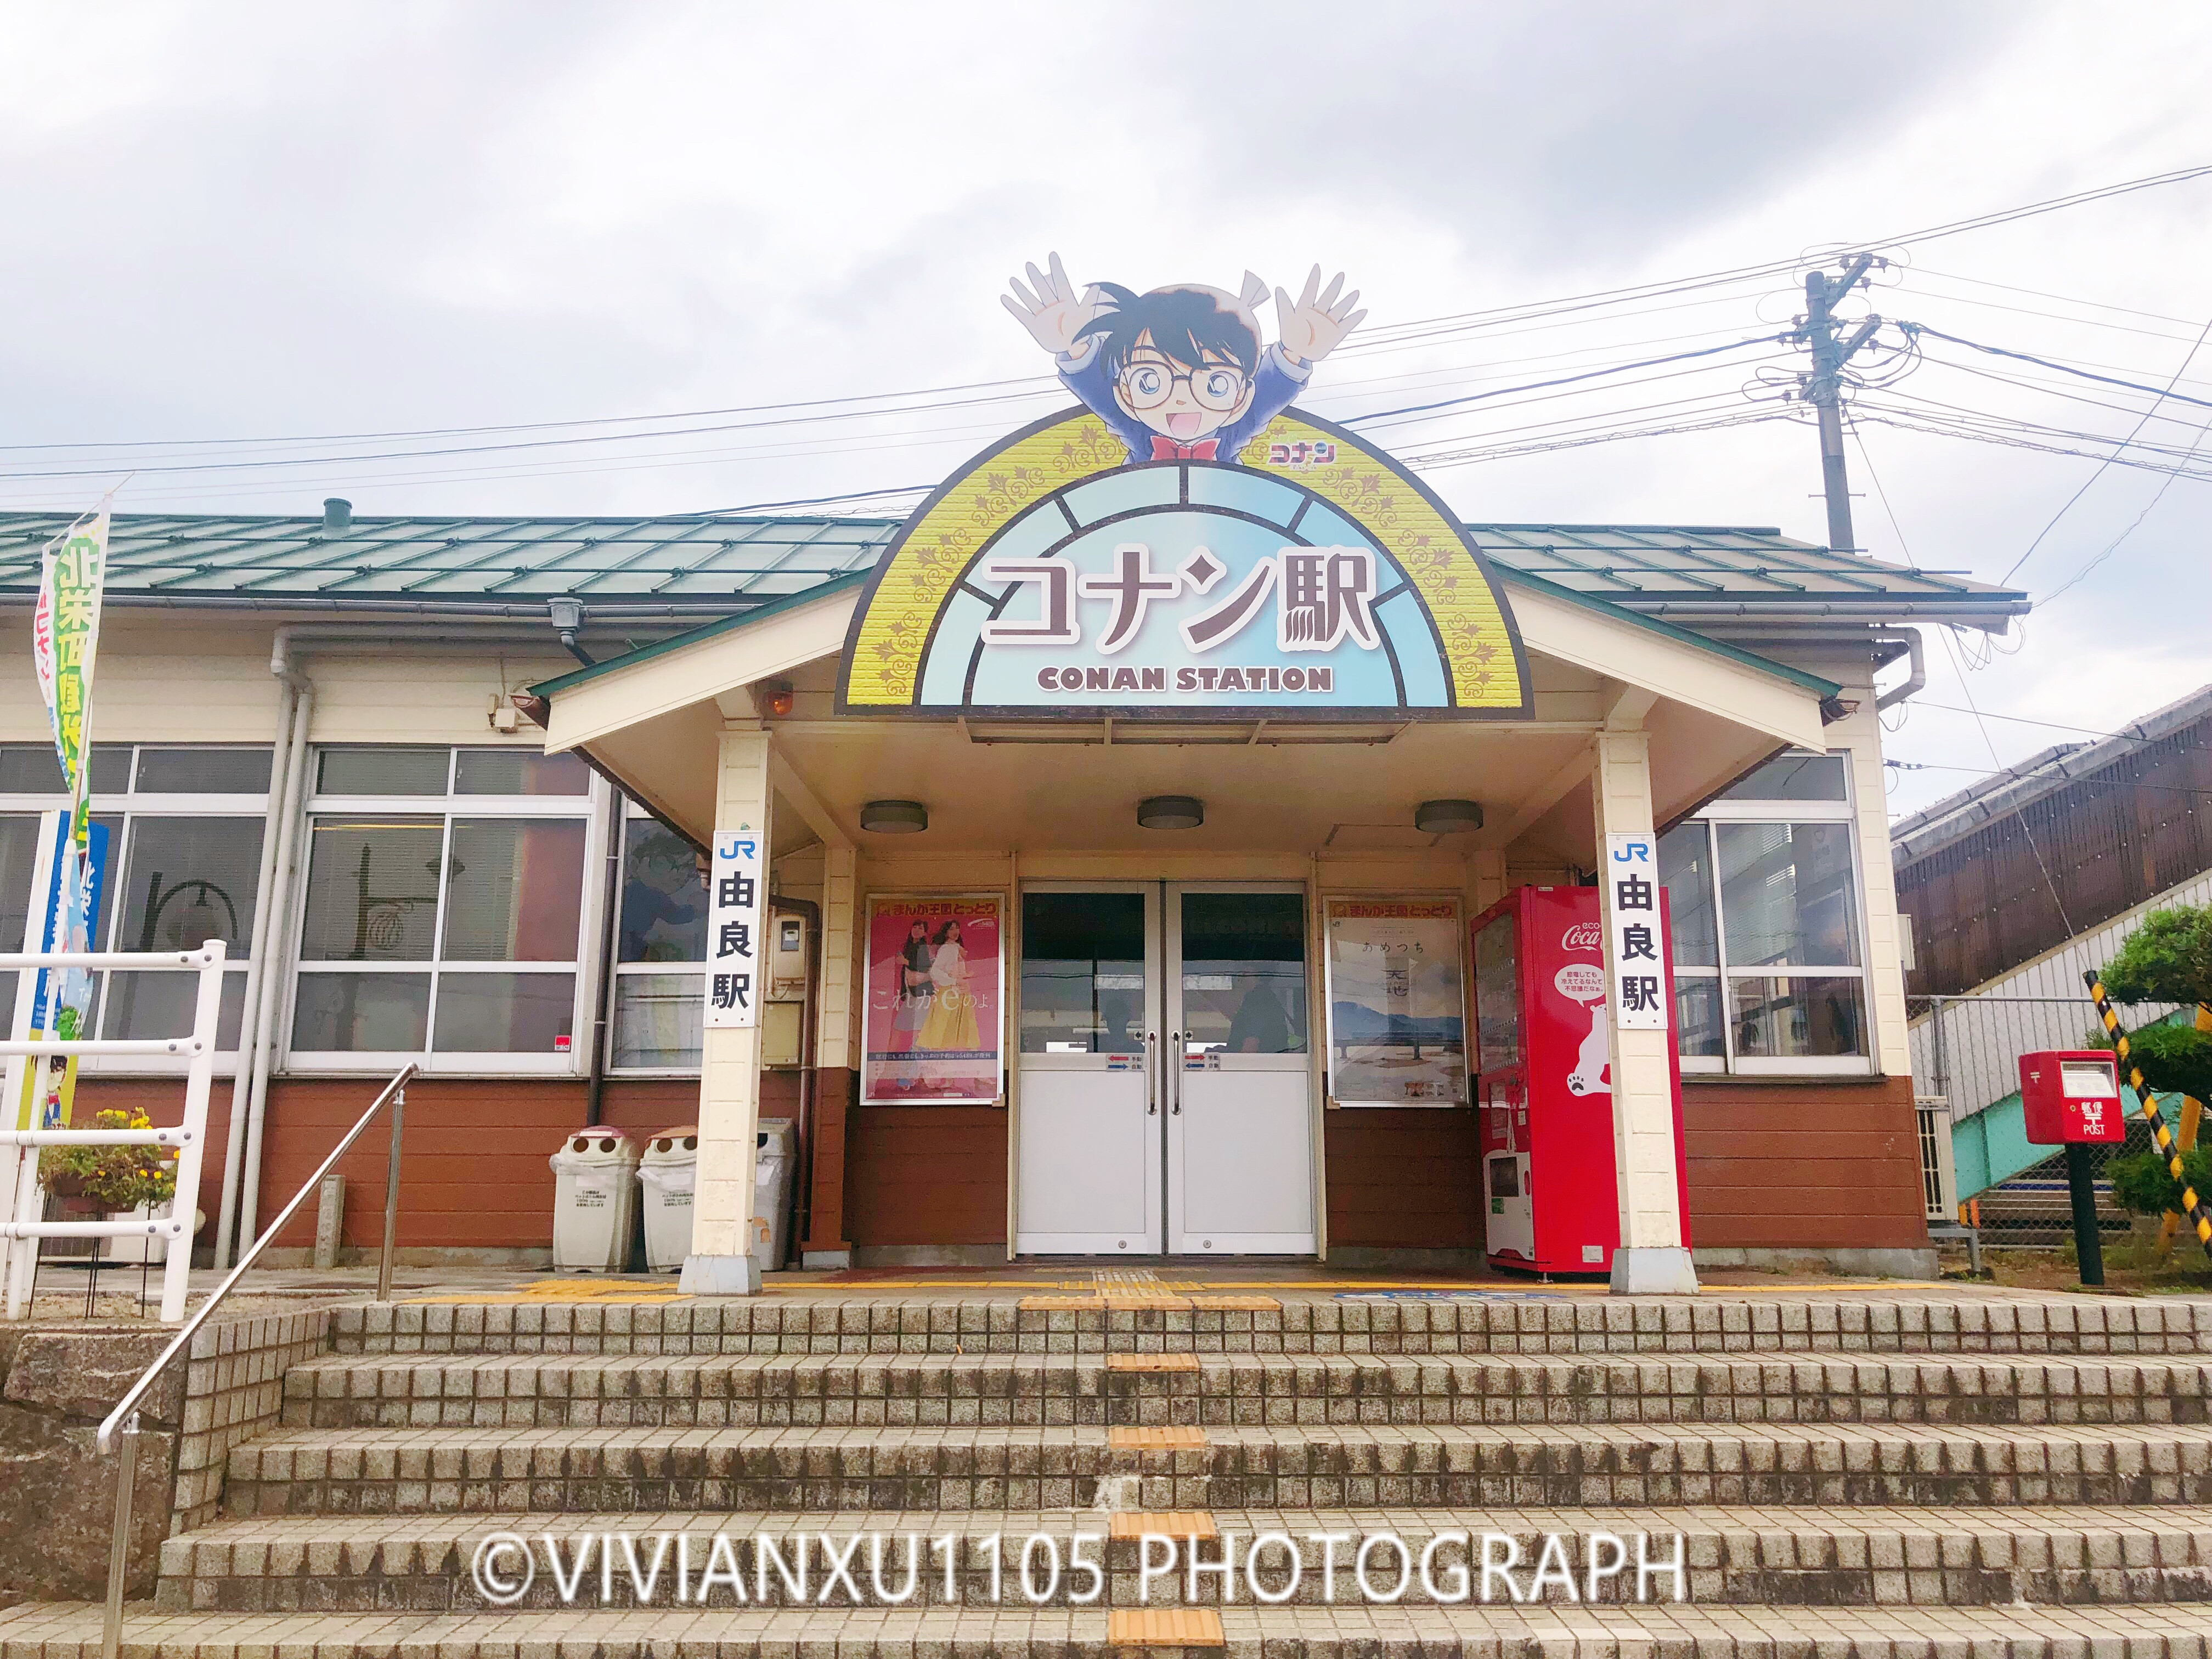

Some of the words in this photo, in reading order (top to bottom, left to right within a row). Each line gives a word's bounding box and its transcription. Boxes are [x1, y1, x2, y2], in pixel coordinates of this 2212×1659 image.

[1268, 442, 1336, 464] コナン
[985, 548, 1376, 650] コナン駅
[1037, 667, 1166, 692] CONAN
[1176, 667, 1333, 692] STATION
[720, 840, 755, 859] JR
[1614, 843, 1649, 862] JR
[712, 871, 754, 1009] 由良駅
[1363, 941, 1423, 953] あめつち
[1617, 873, 1660, 1011] 由良駅
[2081, 1101, 2103, 1114] 郵便
[2083, 1125, 2105, 1135] POST
